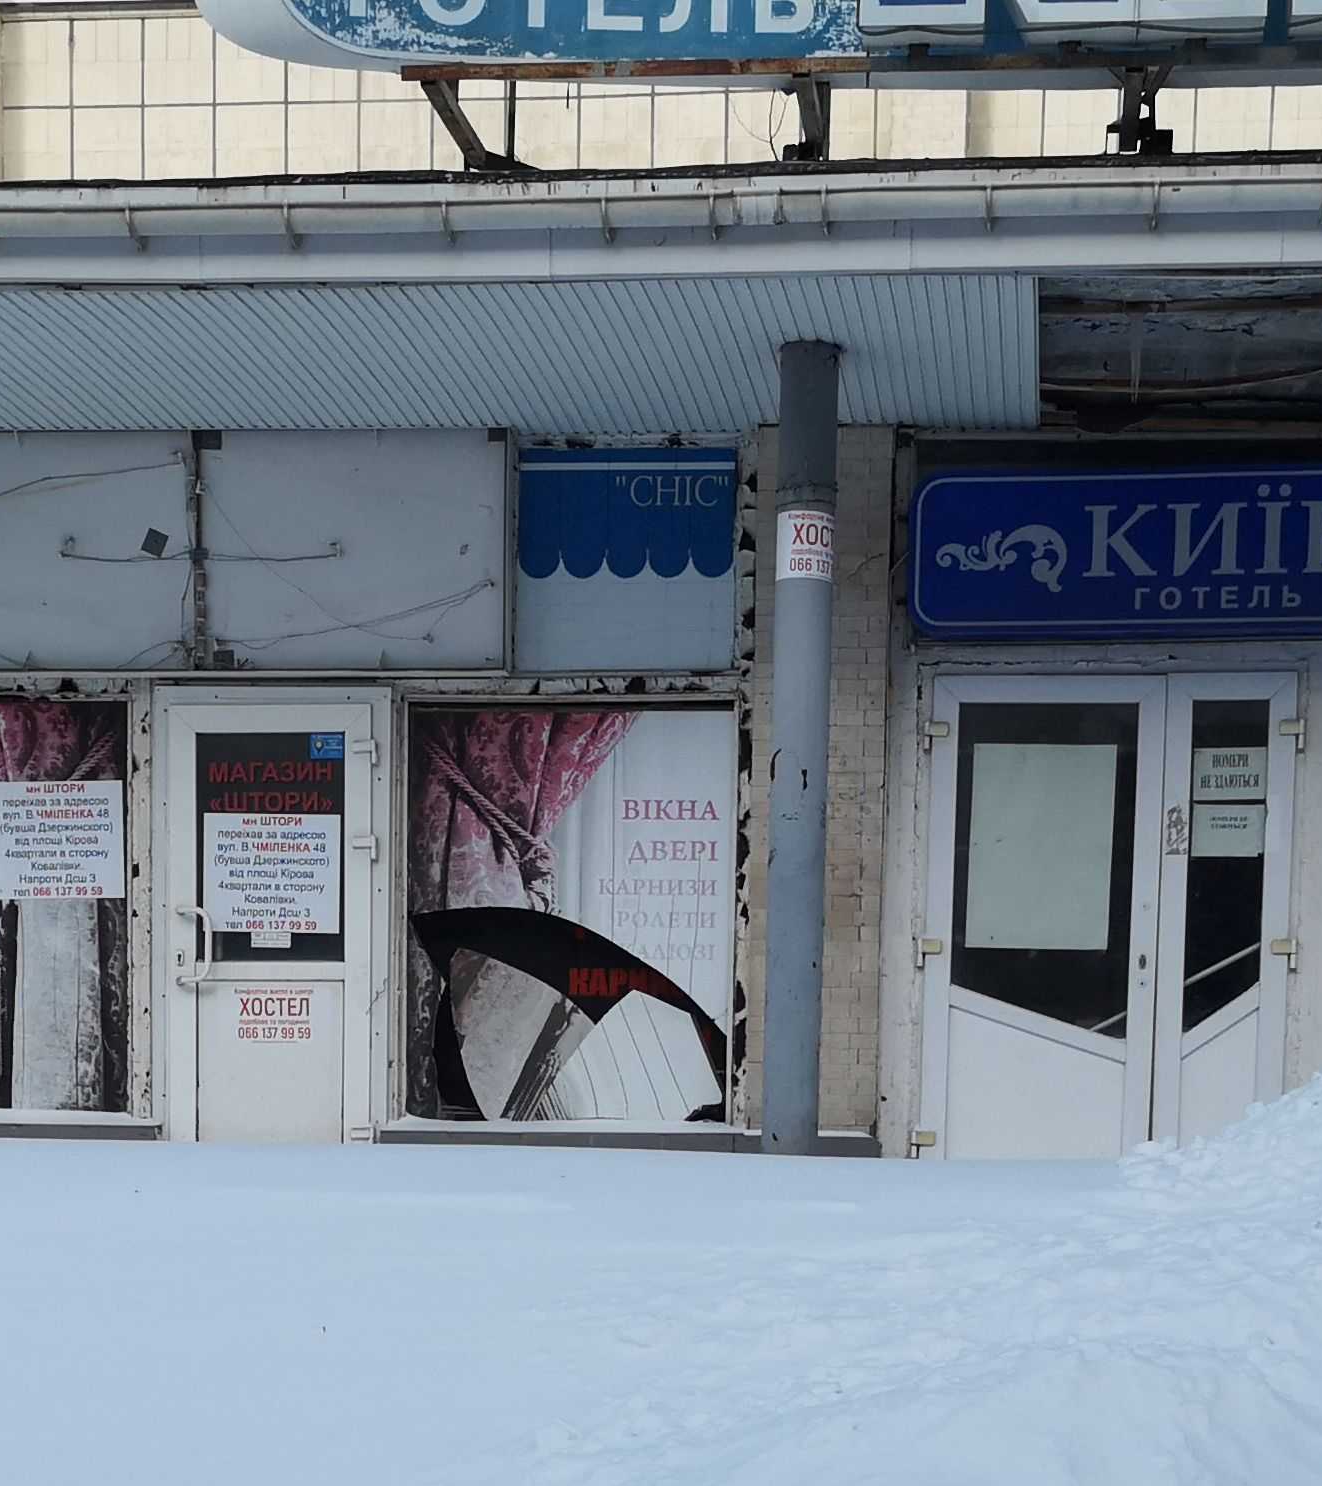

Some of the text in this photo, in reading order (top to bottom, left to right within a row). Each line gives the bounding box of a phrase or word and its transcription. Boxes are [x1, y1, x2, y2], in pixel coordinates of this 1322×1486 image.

[790, 558, 812, 572] 066
[1134, 585, 1302, 610] ГОТЕЛЬ
[1211, 754, 1250, 768] НОМЕРИ
[208, 761, 335, 783] МАГАЗИН
[1200, 774, 1260, 789] НЕ ЗДАЮТЬСЯ
[43, 784, 85, 793] ШТОРИ
[64, 798, 109, 808] адресою
[210, 792, 334, 812] «ШТОРИ»
[97, 809, 109, 818] 48
[622, 799, 719, 820] ВІКНА
[260, 816, 302, 826] ШТОРИ
[0, 823, 36, 834] (бувша
[65, 835, 99, 845] Кірова
[217, 830, 326, 841] переїхав за адресою
[312, 844, 325, 852] 48
[629, 840, 719, 865] ДВЕРІ
[68, 849, 109, 859] сторону
[214, 855, 250, 867] (бувша
[19, 874, 62, 884] Напроти
[229, 869, 314, 880] від площі Кірова
[33, 888, 51, 896] 066
[55, 887, 72, 896] 137
[76, 887, 87, 896] 99
[91, 887, 103, 896] 59
[283, 883, 325, 894] сторону
[598, 878, 718, 896] КАРНИЗИ
[232, 908, 275, 918] Напроти
[246, 920, 264, 930] 066
[268, 920, 285, 930] 137
[289, 920, 301, 930] 99
[304, 920, 317, 930] 59
[616, 912, 716, 929] РОЛЕТИ
[239, 998, 310, 1016] ХОСТЕЛ
[238, 1027, 311, 1039] 066 137 99 59
